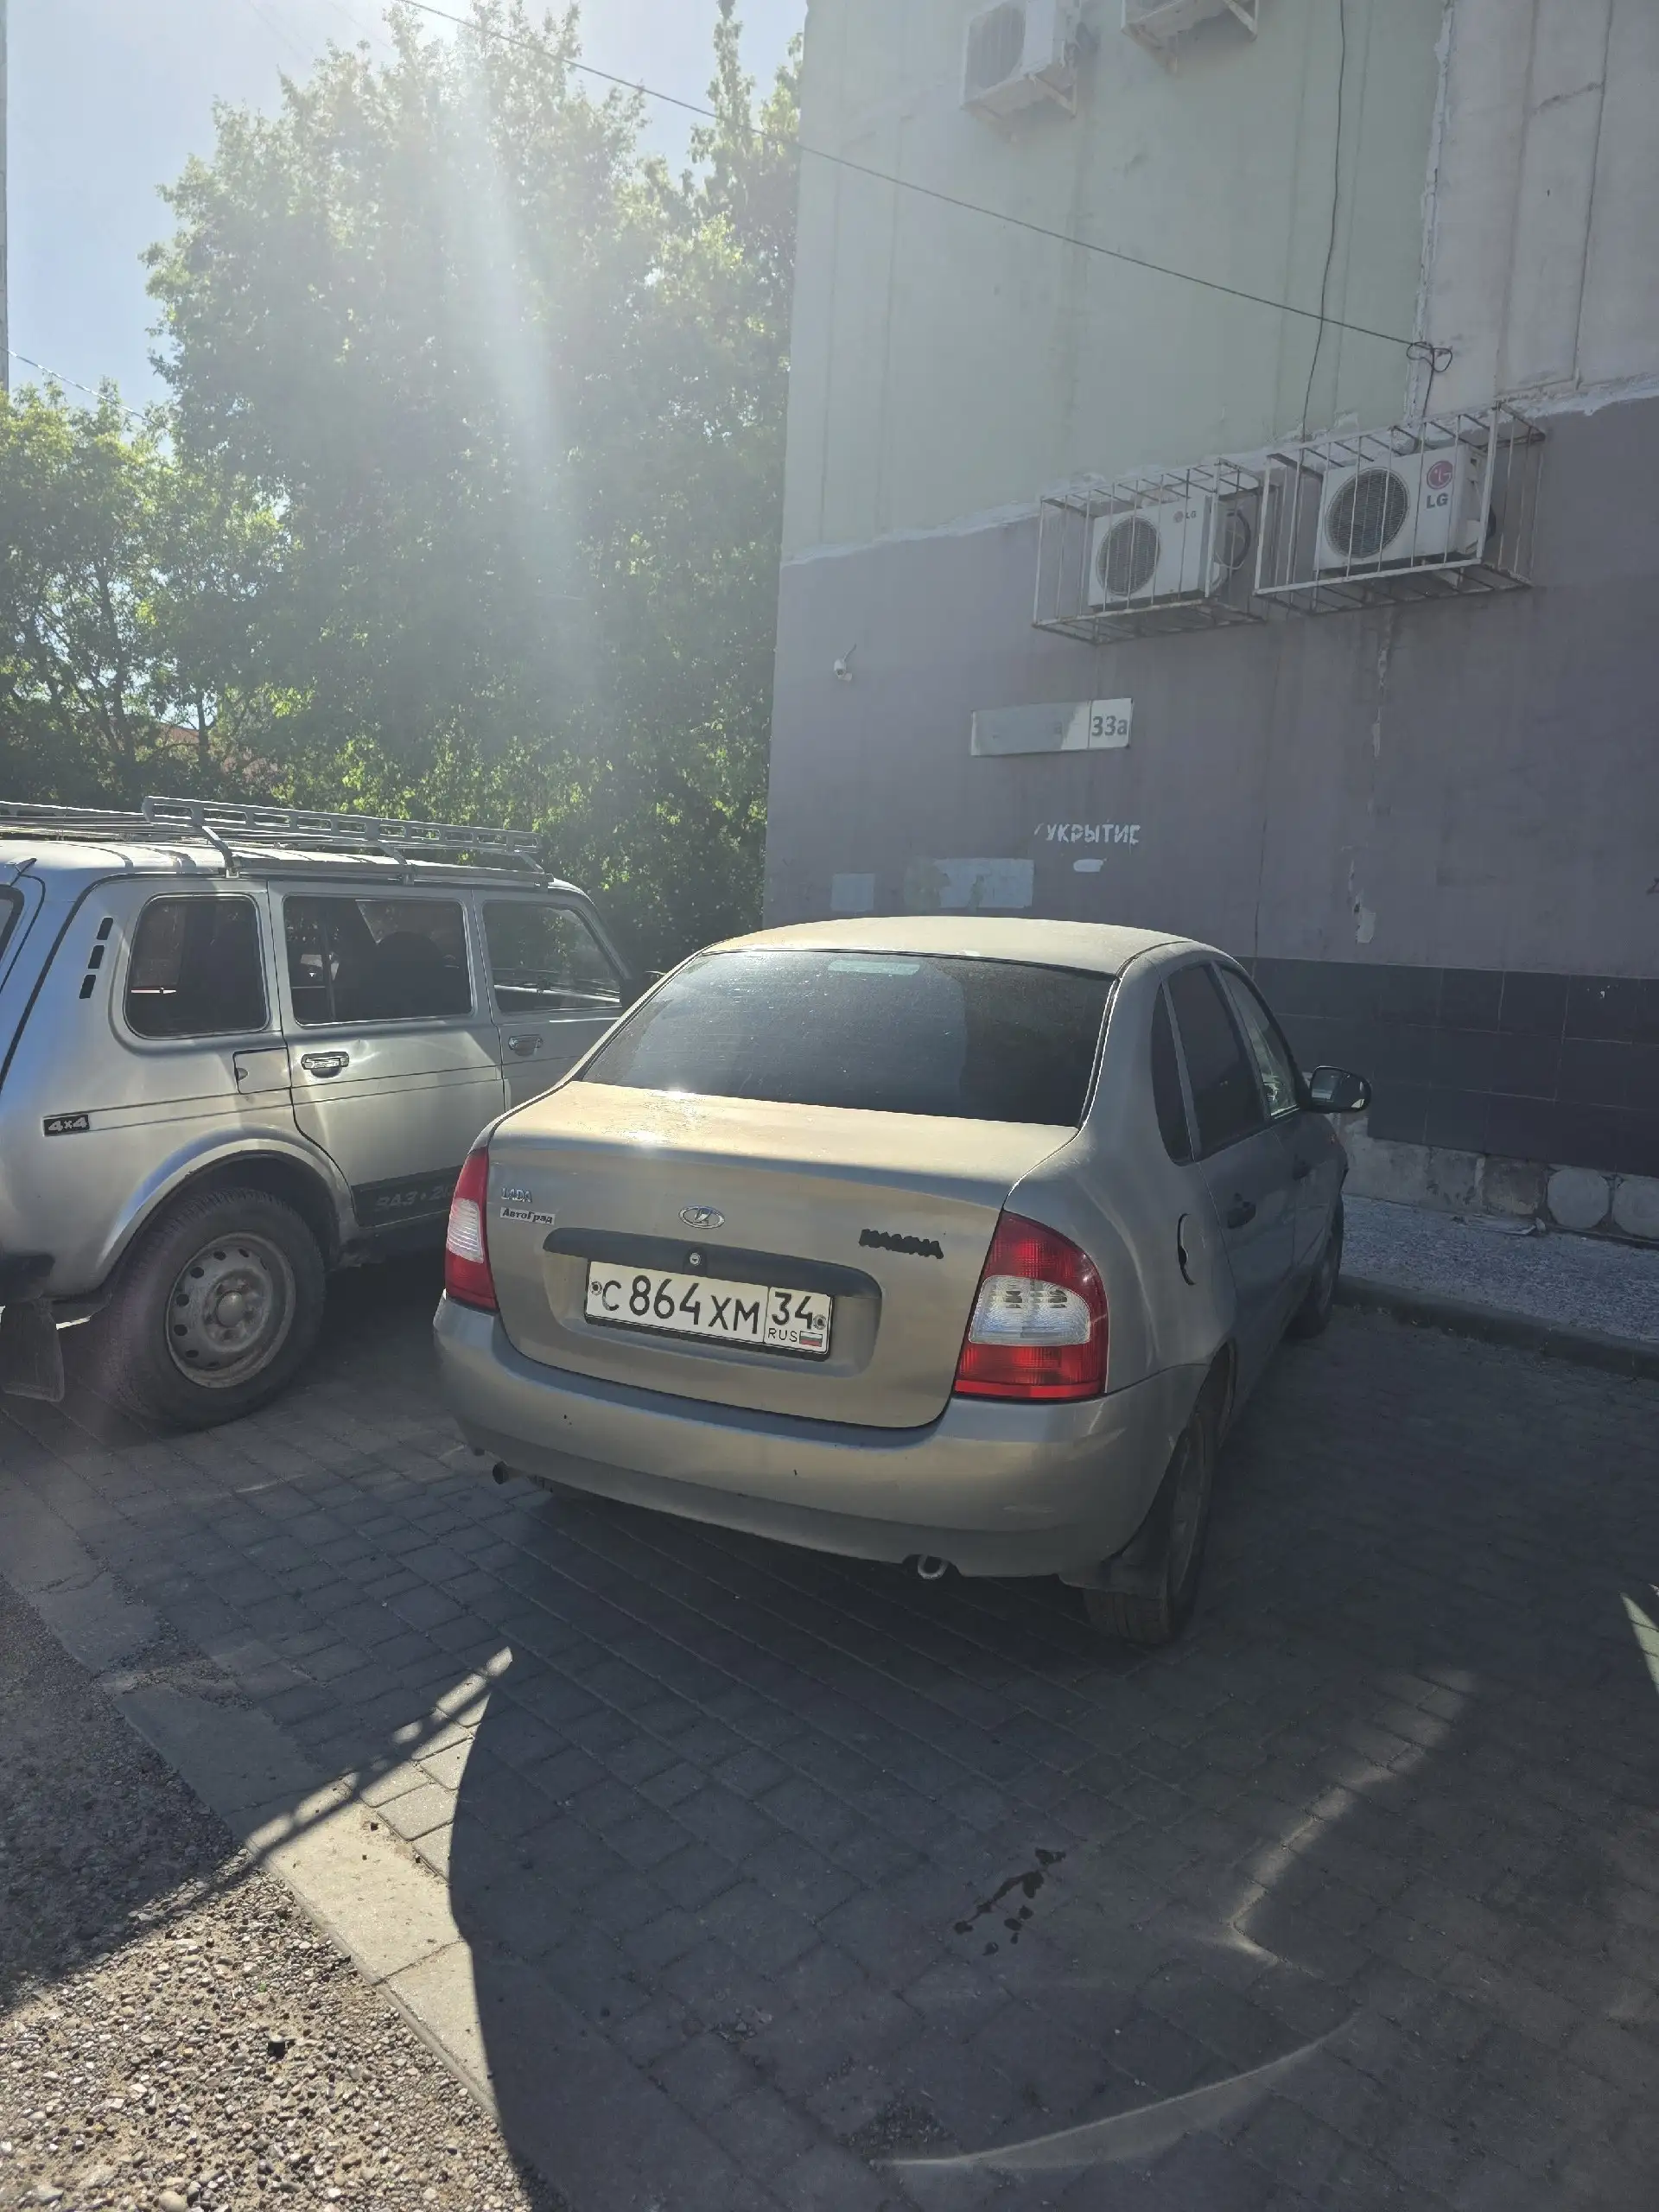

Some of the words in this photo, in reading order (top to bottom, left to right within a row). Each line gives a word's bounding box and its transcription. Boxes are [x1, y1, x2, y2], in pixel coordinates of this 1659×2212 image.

[1427, 493, 1449, 509] LG
[1091, 715, 1128, 737] 33а
[501, 1187, 532, 1203] LADA
[502, 1208, 553, 1224] АвтоГрад
[771, 1291, 813, 1330] 34
[767, 1327, 798, 1343] RUS
